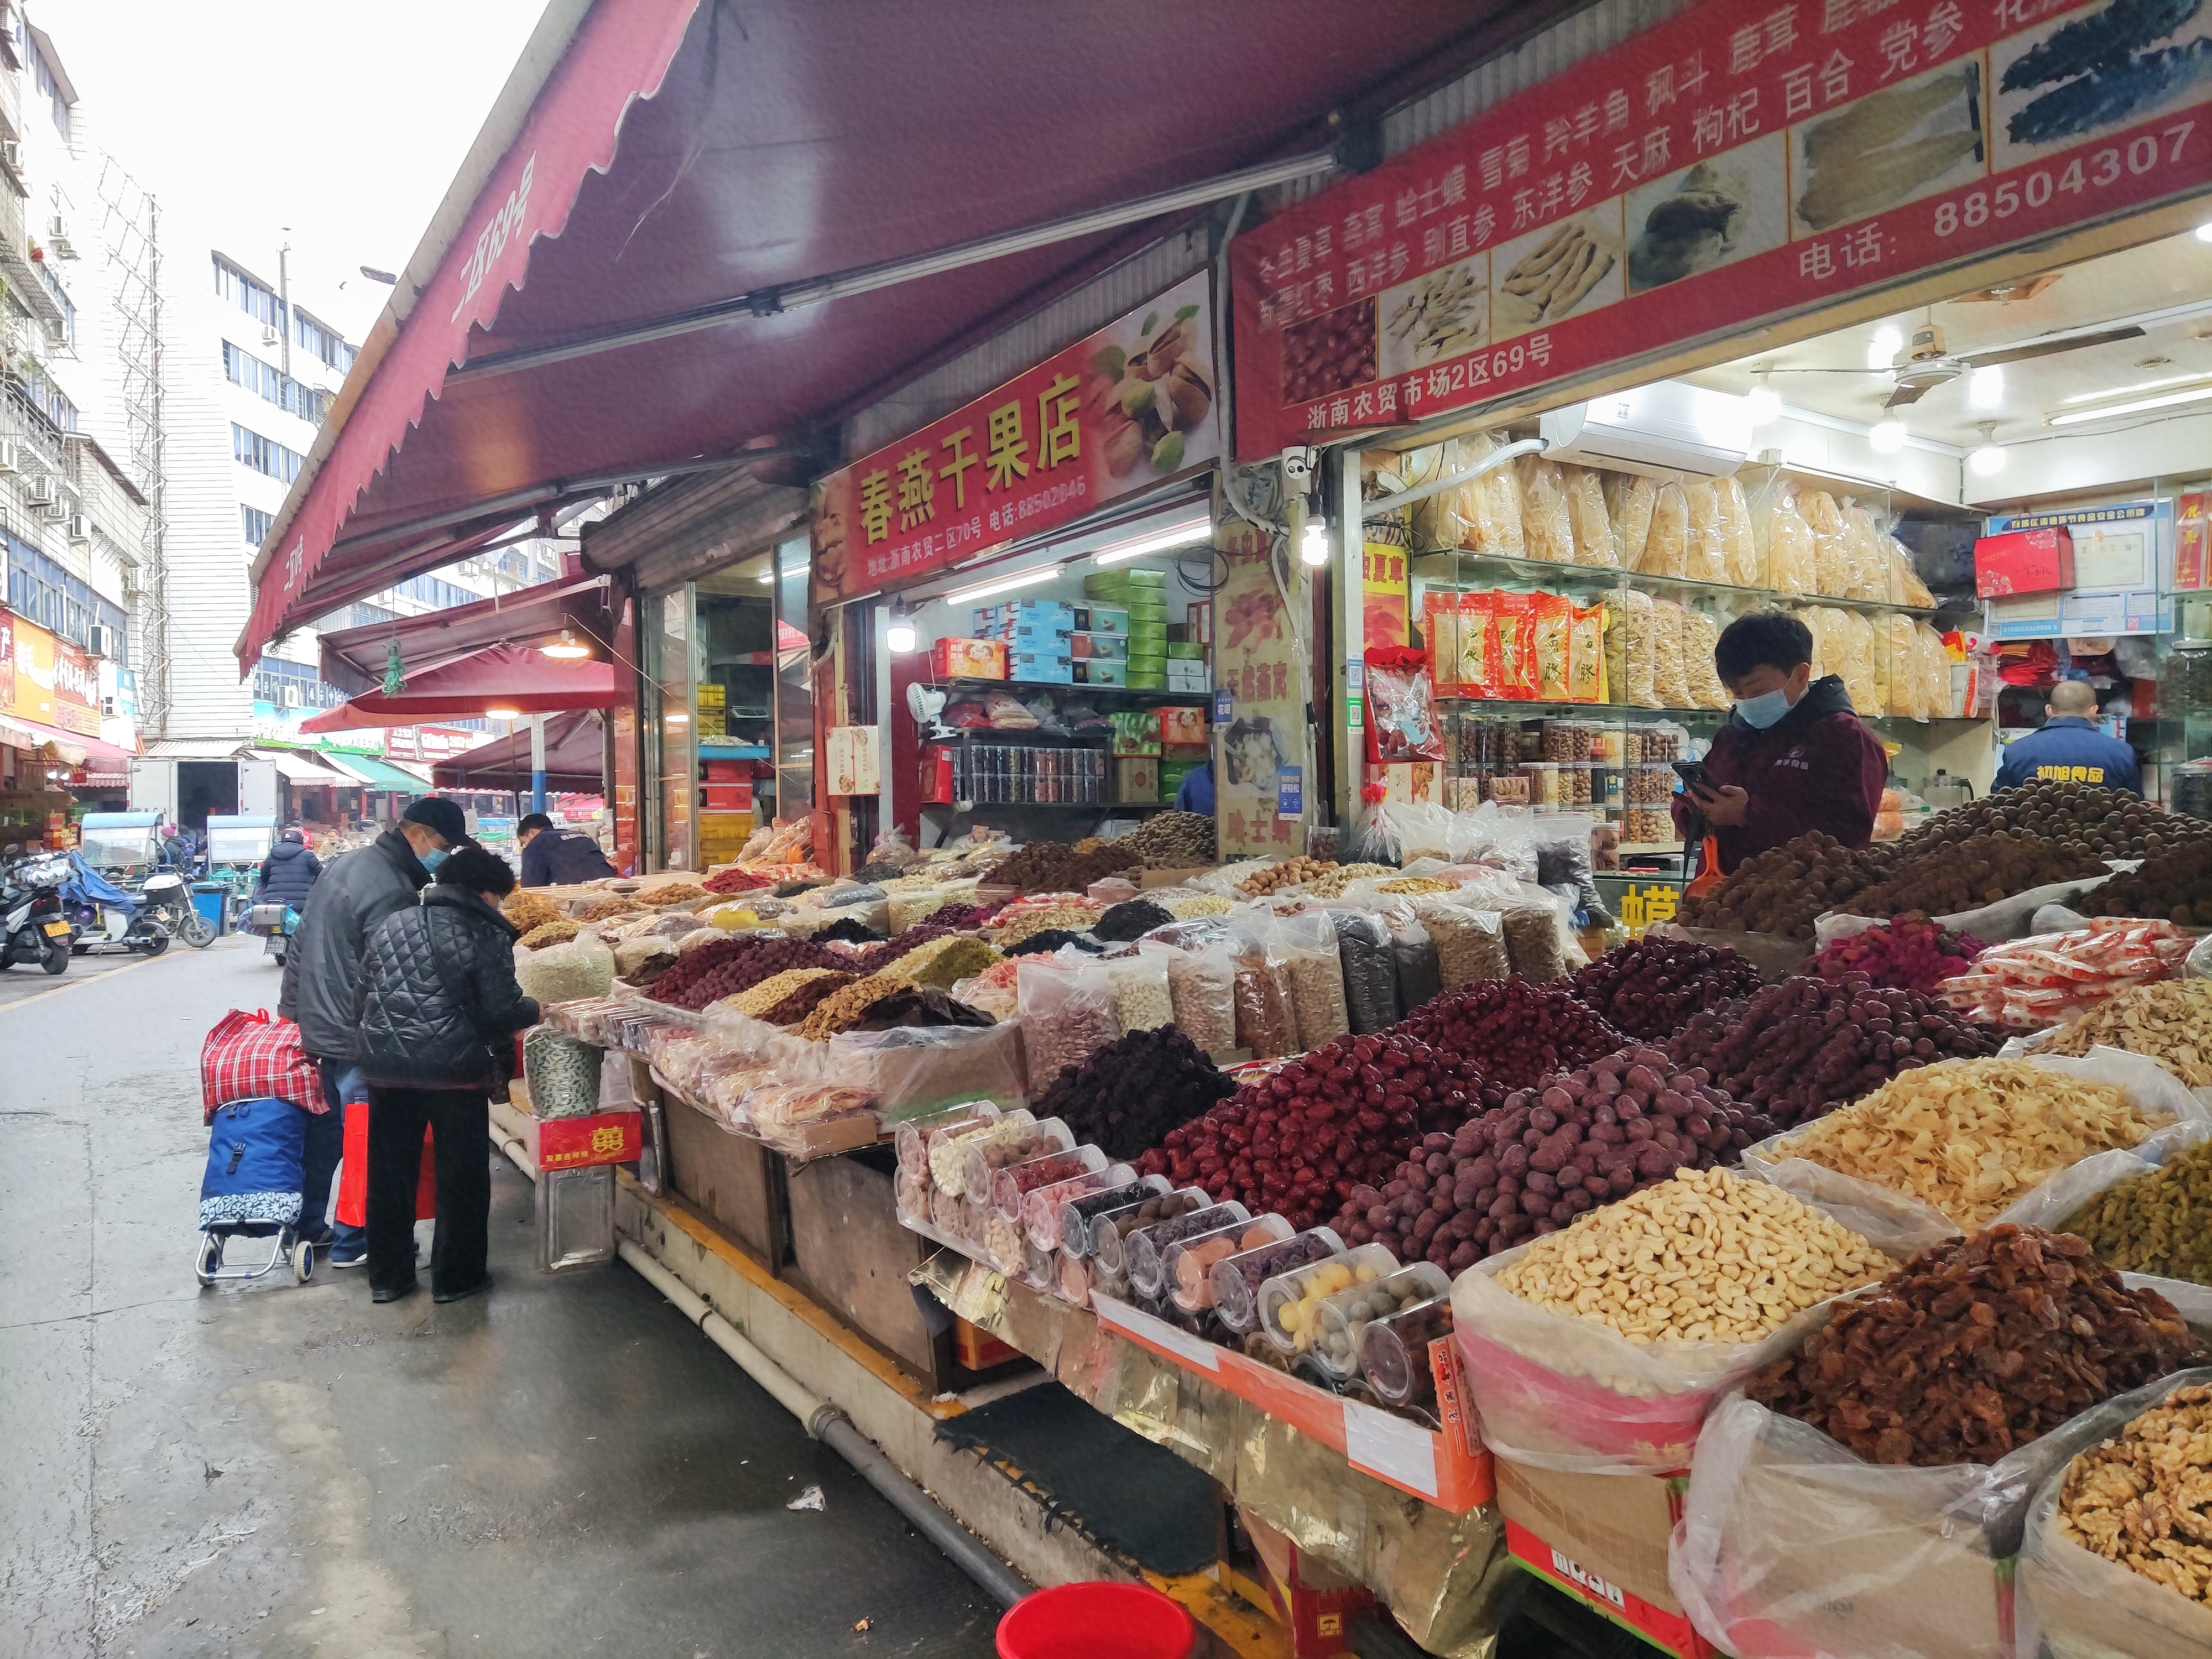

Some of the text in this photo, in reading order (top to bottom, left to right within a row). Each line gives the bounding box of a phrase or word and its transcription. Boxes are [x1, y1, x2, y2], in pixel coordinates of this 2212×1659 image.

[1346, 240, 1410, 299] 西洋参
[1511, 161, 1593, 231] 东洋参
[1611, 125, 1671, 189] 天麻
[1692, 88, 1760, 155] 枸杞
[1781, 49, 1855, 118] 百合
[1876, 1, 1964, 83] 党参
[1933, 121, 2195, 238] 88504307
[1306, 333, 1553, 430] 浙南农贸市场2区69号
[860, 373, 1081, 545] 春燕干果店
